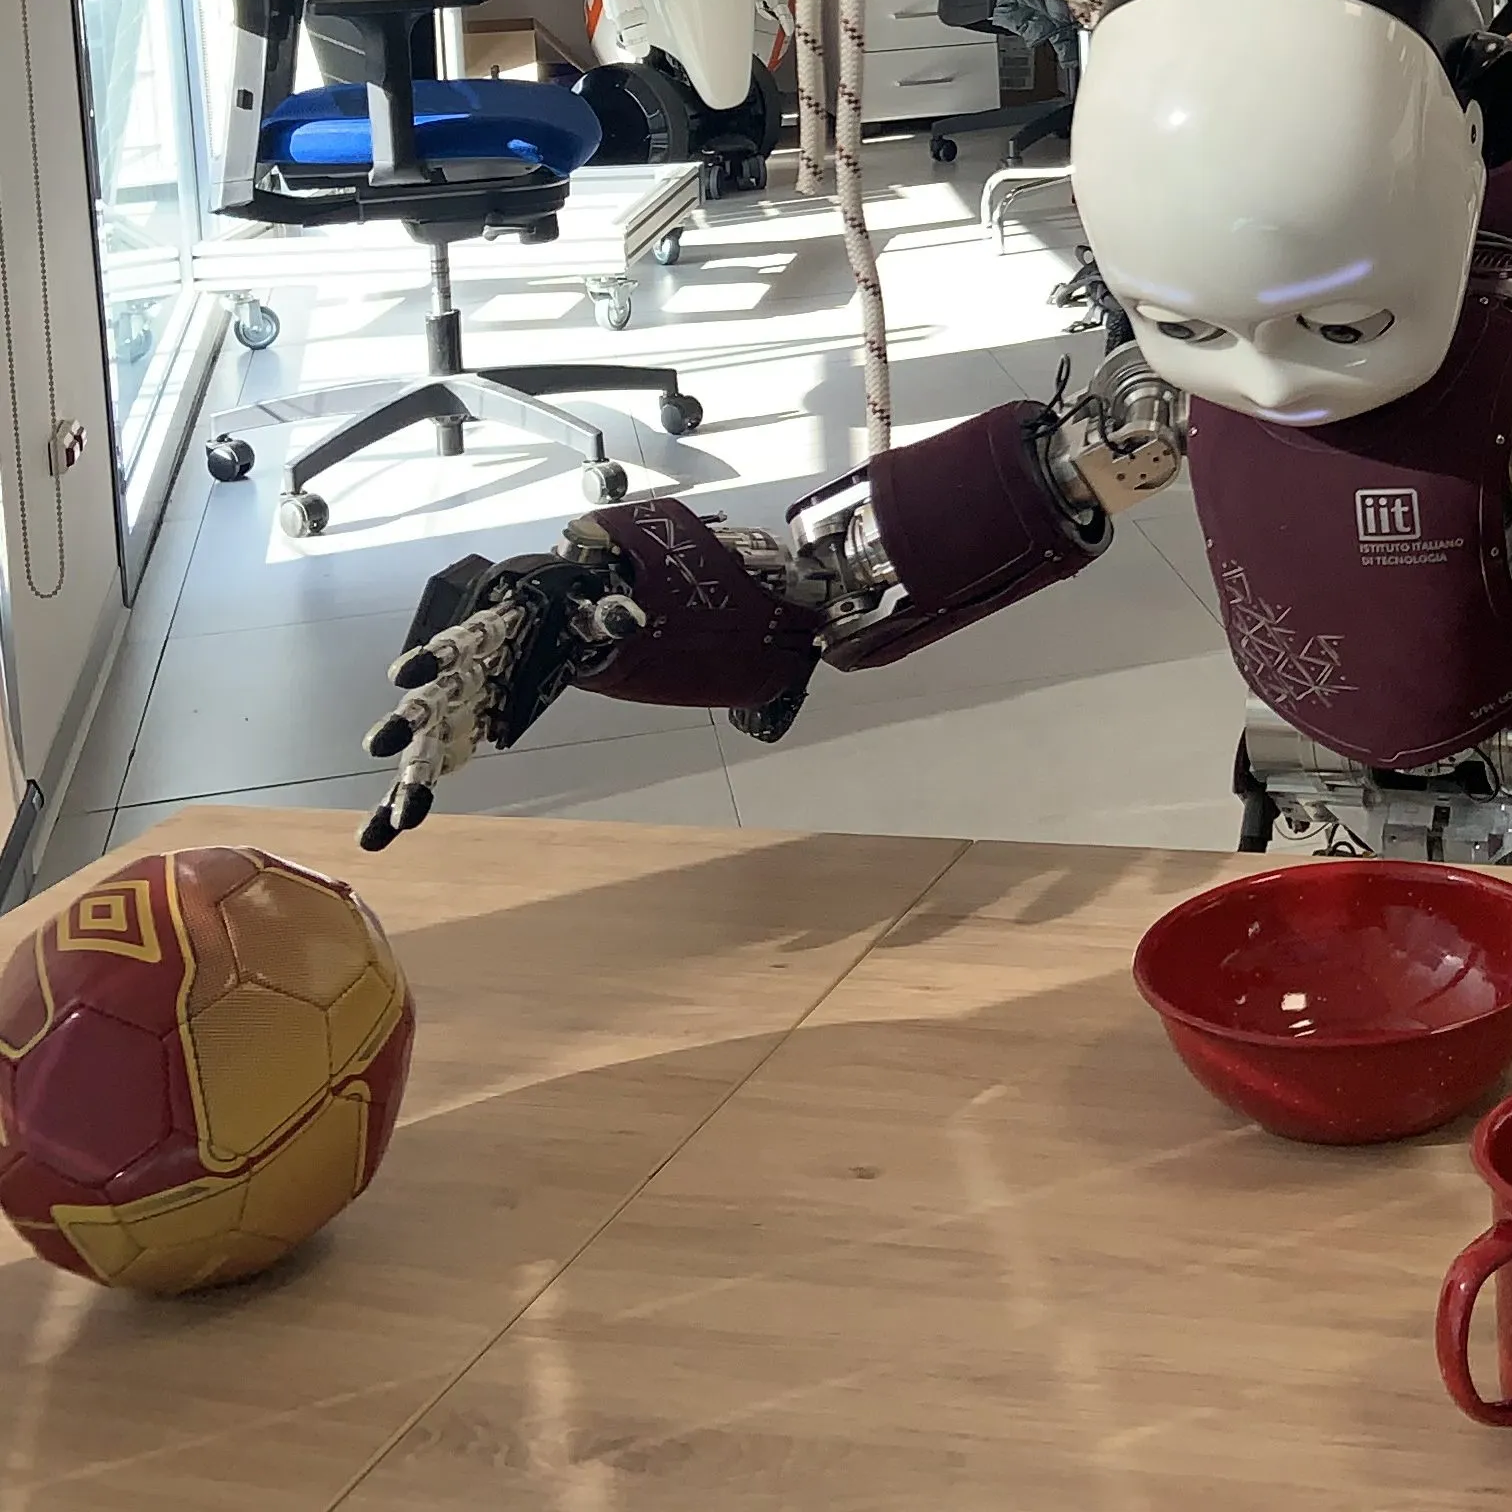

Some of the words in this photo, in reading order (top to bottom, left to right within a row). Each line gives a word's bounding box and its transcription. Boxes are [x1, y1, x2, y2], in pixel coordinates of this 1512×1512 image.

[1365, 497, 1411, 534] iit
[1360, 542, 1410, 554] ISTITUTO
[1412, 538, 1464, 551] ITALIANO
[1362, 556, 1374, 566] DI
[1375, 553, 1448, 566] TECNOLOGIA
